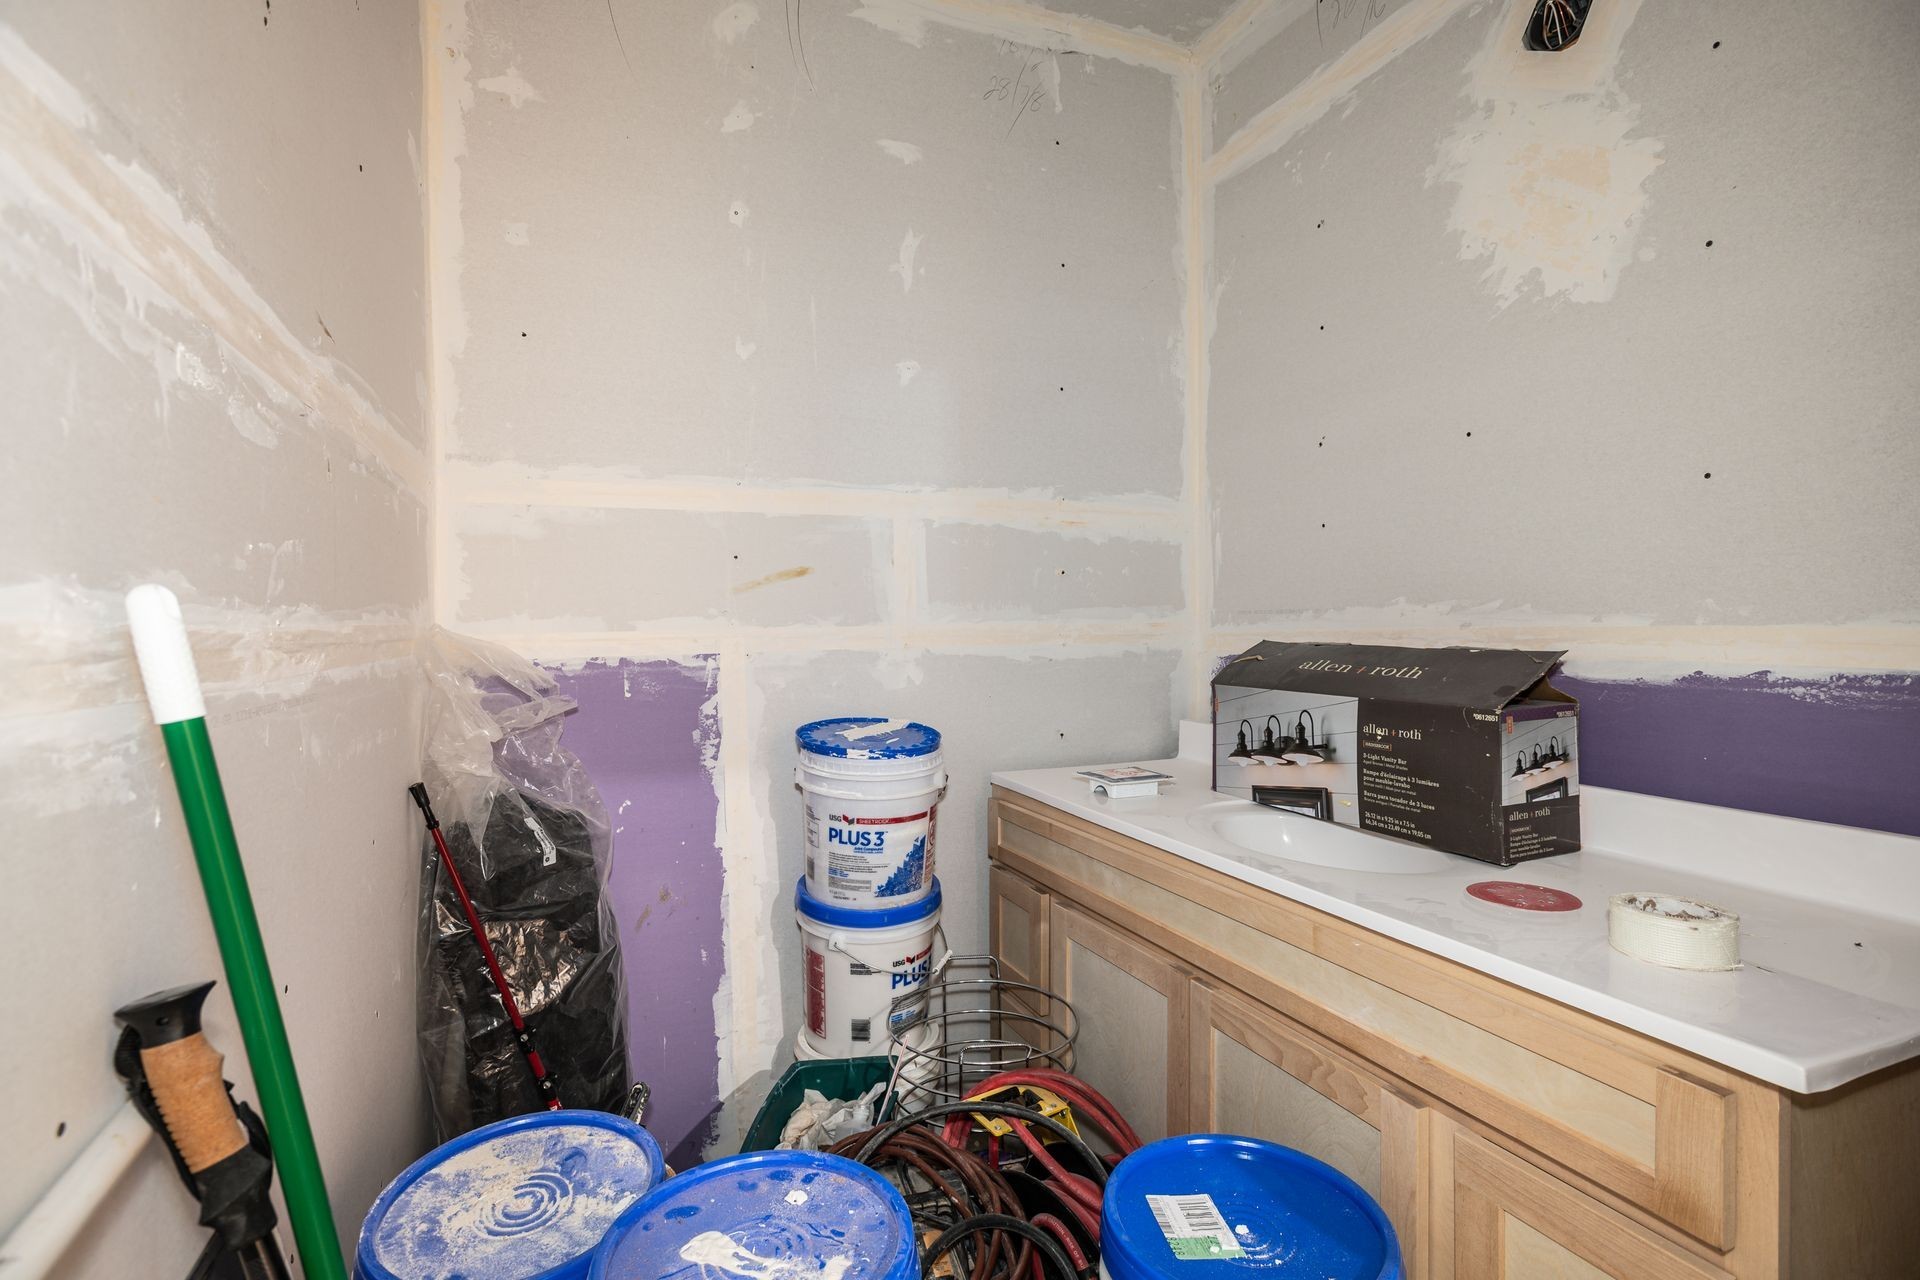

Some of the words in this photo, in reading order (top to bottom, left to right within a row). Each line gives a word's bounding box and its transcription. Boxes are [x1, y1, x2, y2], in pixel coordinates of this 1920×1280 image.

[1298, 660, 1352, 673] allen
[1369, 666, 1422, 679] roth
[1362, 724, 1388, 736] allen
[1398, 729, 1422, 740] roth
[1381, 756, 1398, 764] Vanity
[829, 814, 842, 822] USG
[1509, 811, 1528, 821] allen
[1535, 806, 1550, 817] roth
[828, 827, 871, 847] PLUS
[874, 831, 885, 847] 3
[892, 960, 927, 989] PLUS
